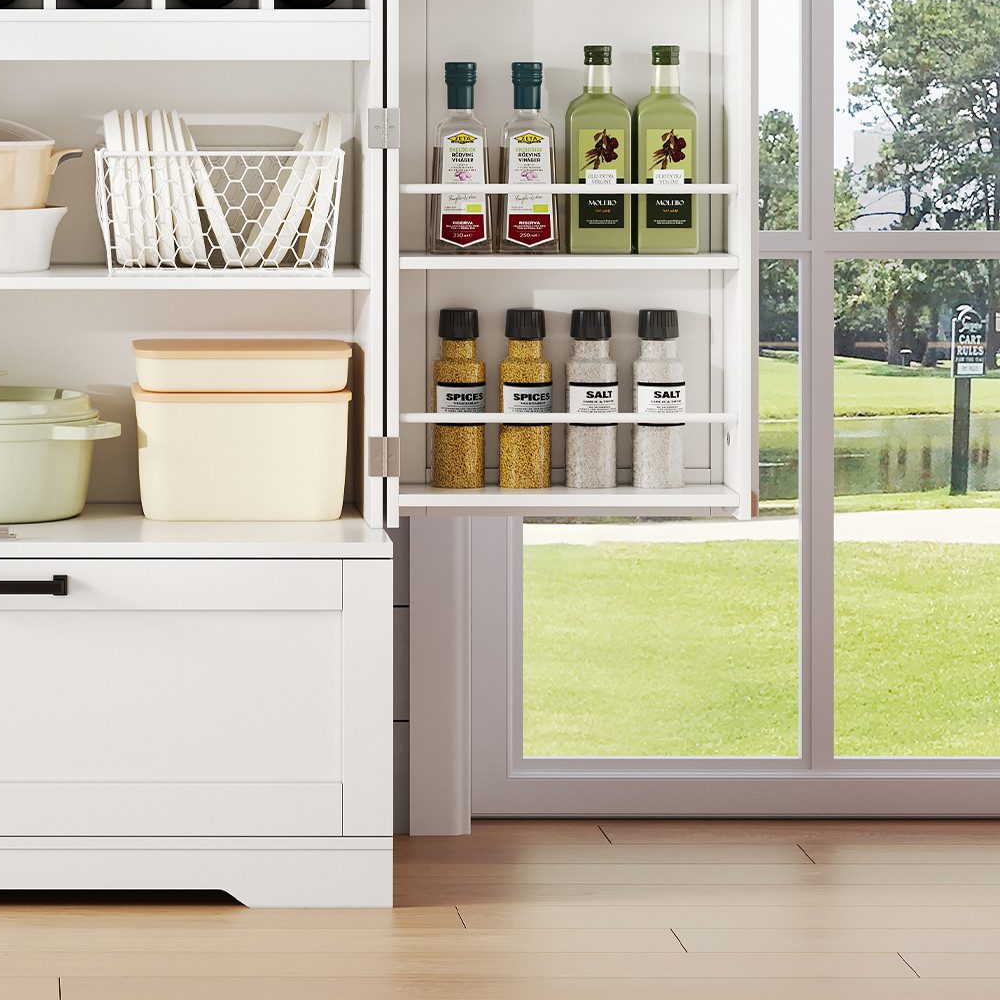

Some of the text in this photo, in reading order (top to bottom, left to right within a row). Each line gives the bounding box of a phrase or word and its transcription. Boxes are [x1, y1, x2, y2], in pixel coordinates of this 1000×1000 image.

[959, 334, 982, 344] CART
[956, 345, 984, 356] RULES
[446, 392, 484, 401] SPICES
[513, 392, 550, 401] SPICES
[586, 390, 612, 399] SALT
[653, 390, 681, 399] SALT
